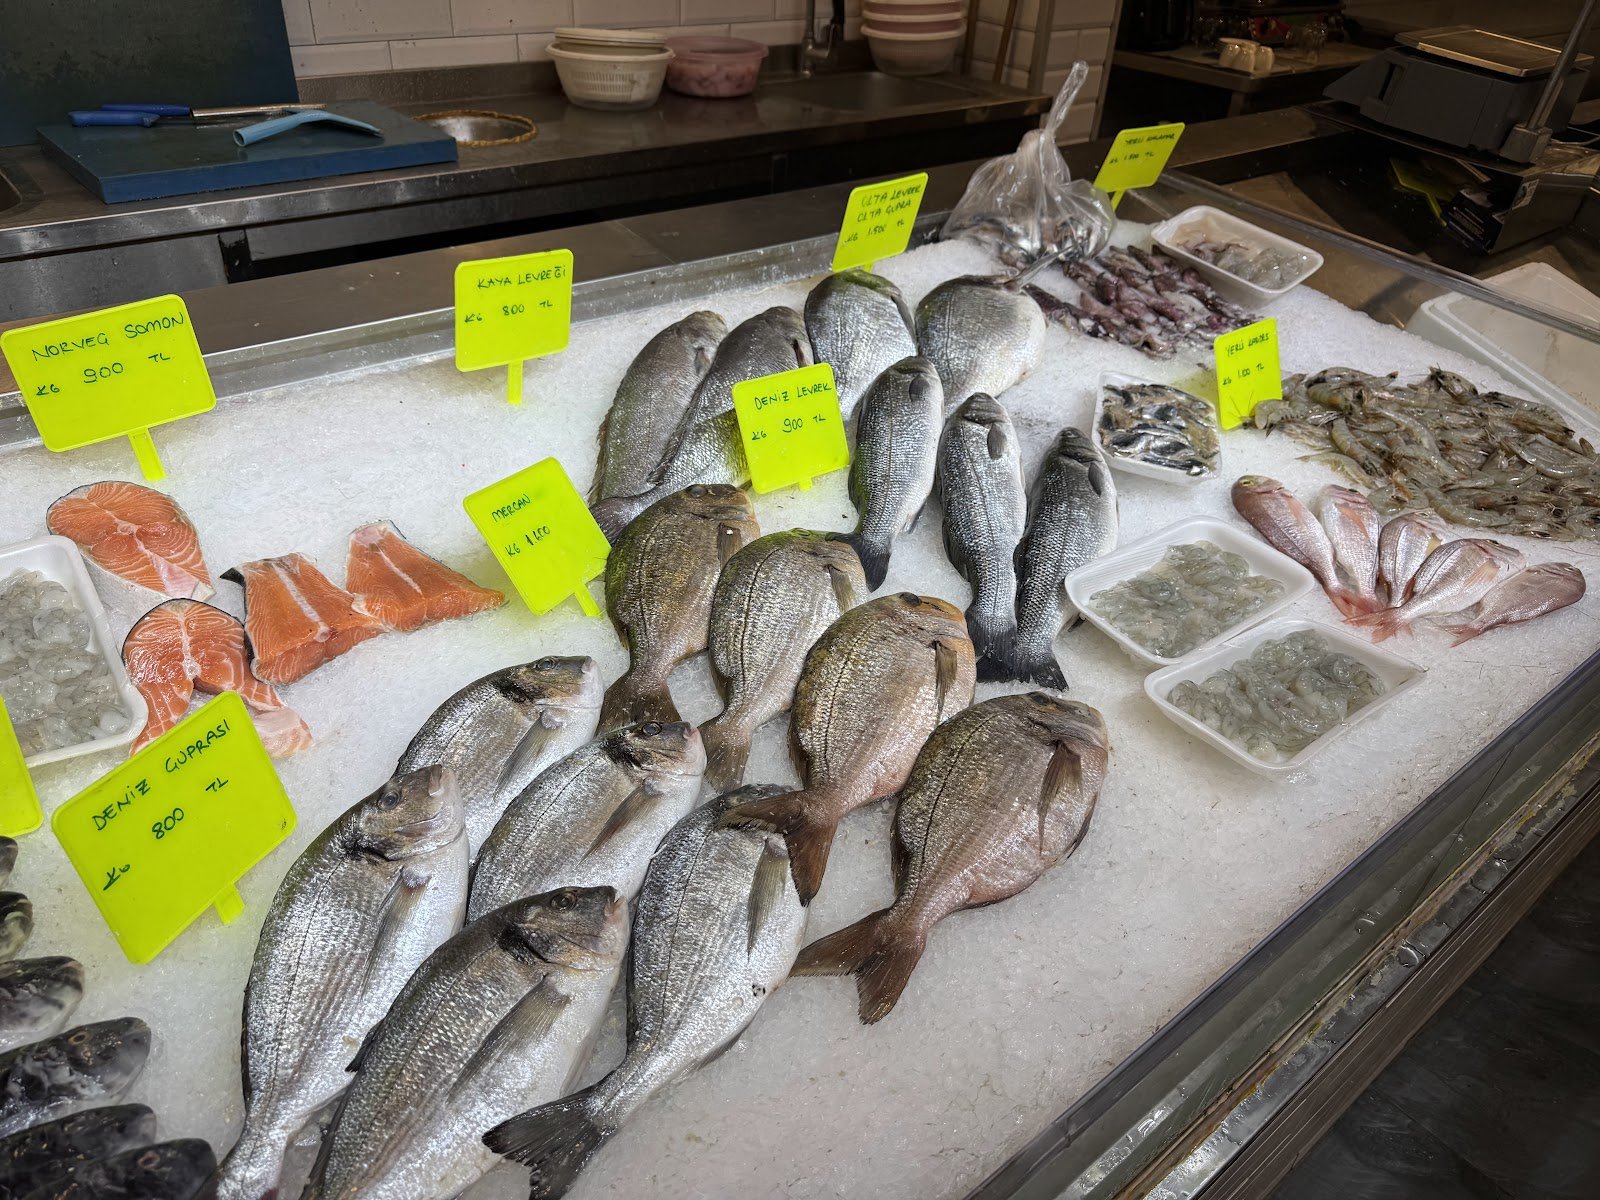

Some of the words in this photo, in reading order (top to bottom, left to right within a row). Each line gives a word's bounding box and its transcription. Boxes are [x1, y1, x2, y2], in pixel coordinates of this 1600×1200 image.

[477, 276, 513, 290] KAYA
[502, 303, 526, 317] 800
[539, 299, 554, 309] TL
[31, 331, 110, 363] NORVEG
[123, 311, 185, 340] SOMON
[35, 383, 61, 397] KG
[83, 362, 125, 385] 900
[147, 352, 172, 364] TL
[796, 382, 833, 399] LEVREK
[751, 430, 768, 441] KG
[782, 417, 804, 434] 900
[812, 413, 828, 423] TL
[491, 493, 532, 523] MERCAN
[504, 542, 522, 557] KG
[151, 807, 186, 841] 800
[204, 777, 230, 793] TL
